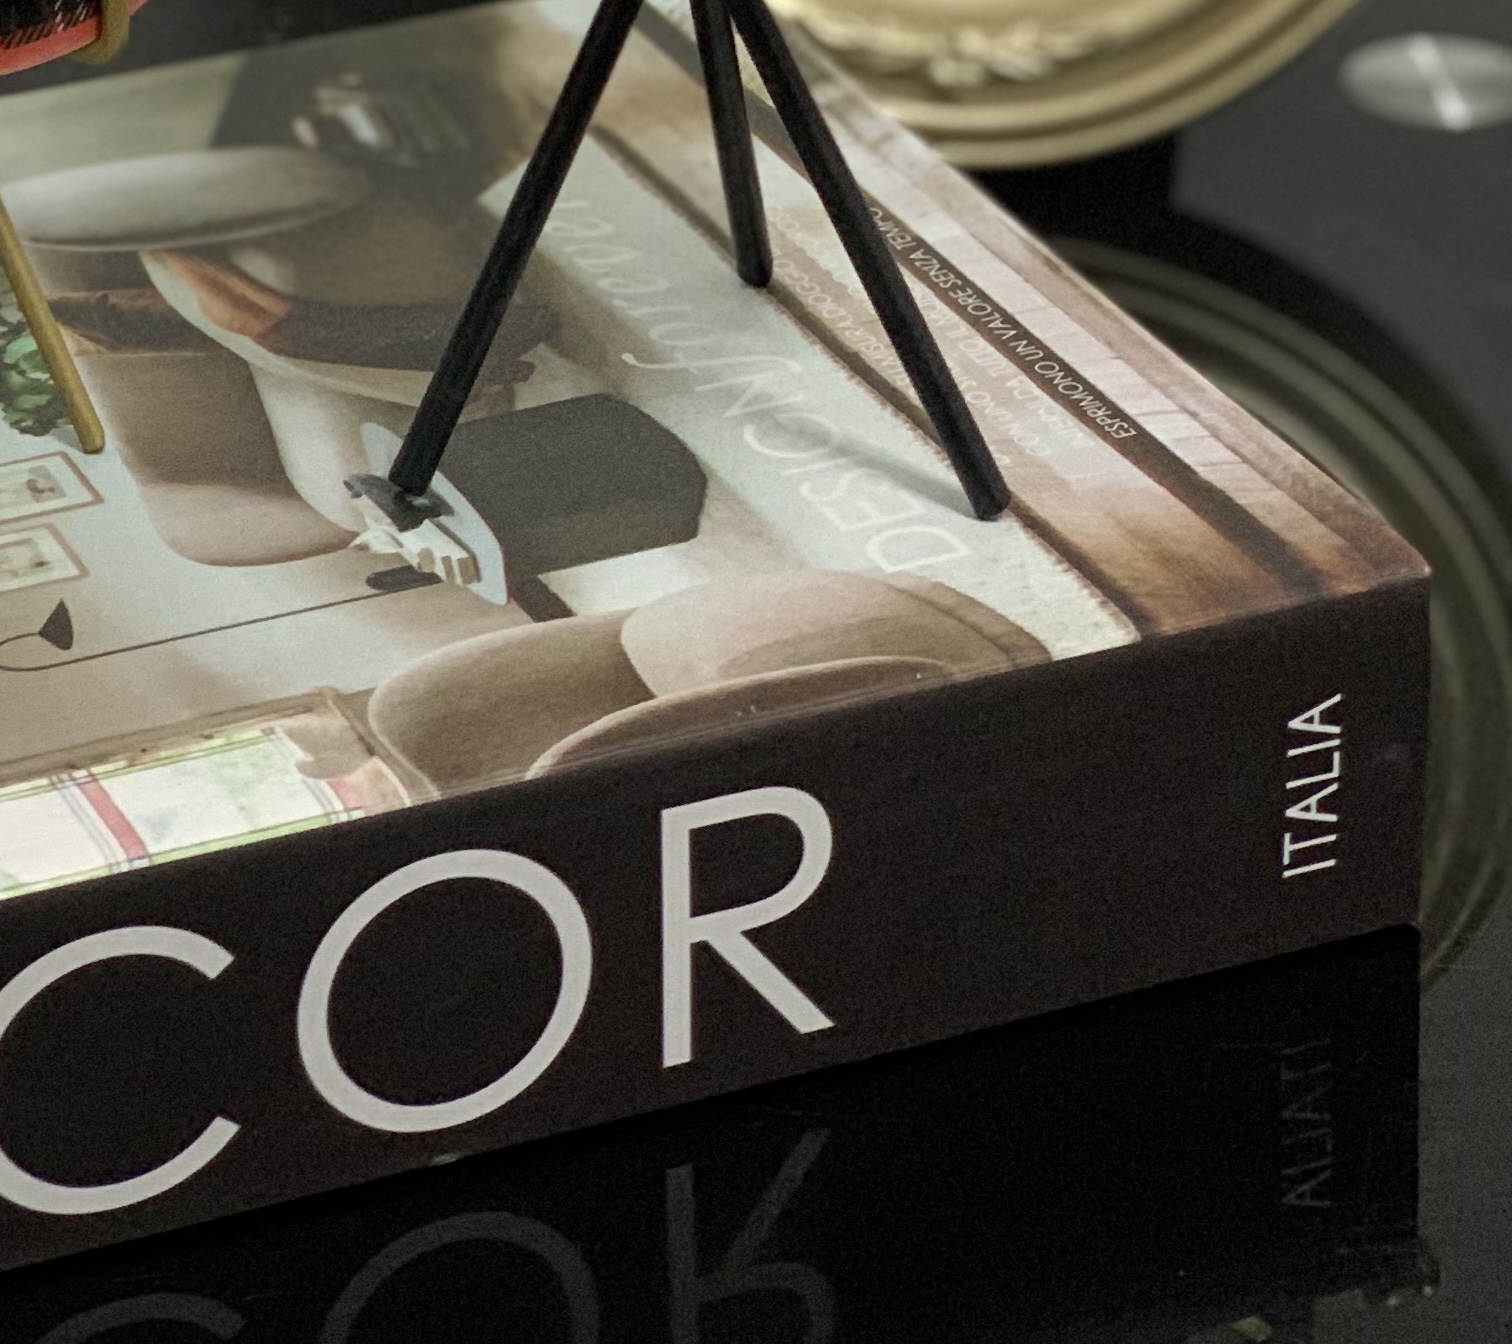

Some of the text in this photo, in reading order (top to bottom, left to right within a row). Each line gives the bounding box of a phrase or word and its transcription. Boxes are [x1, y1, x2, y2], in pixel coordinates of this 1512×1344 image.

[903, 248, 964, 288] SENZA
[945, 287, 1022, 339] VALORE
[1006, 338, 1047, 360] UN
[1028, 359, 1139, 438] ESPRIMONO
[1281, 692, 1343, 880] ITALIA
